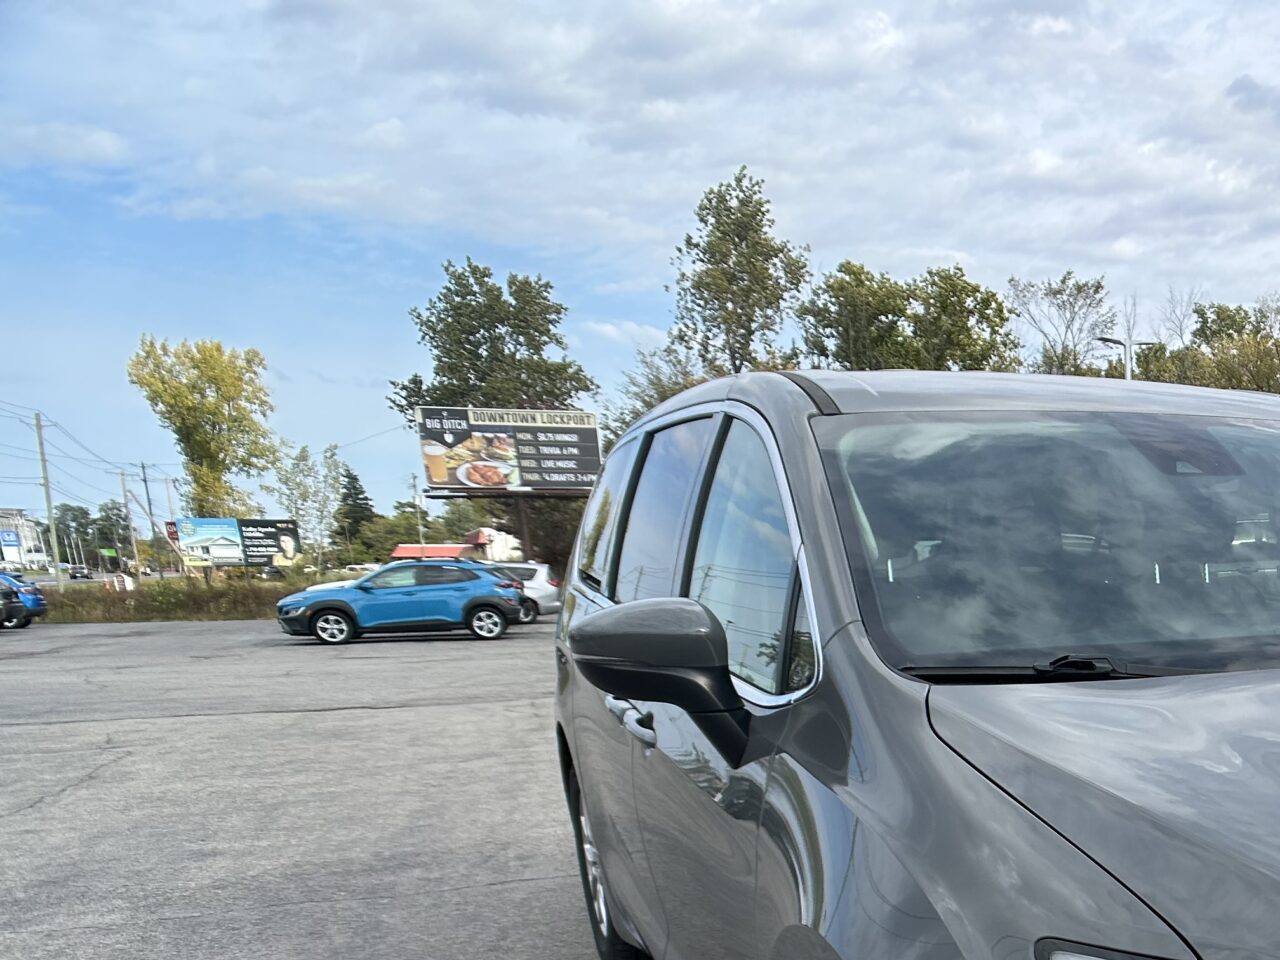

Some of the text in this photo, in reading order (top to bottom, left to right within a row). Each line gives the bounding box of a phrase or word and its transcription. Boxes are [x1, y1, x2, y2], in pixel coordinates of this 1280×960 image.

[425, 418, 469, 430] BIG DITCH
[472, 411, 592, 426] DOWNTOWN LOCKPORT
[540, 459, 555, 468] LIVE
[555, 460, 578, 469] MUSIC
